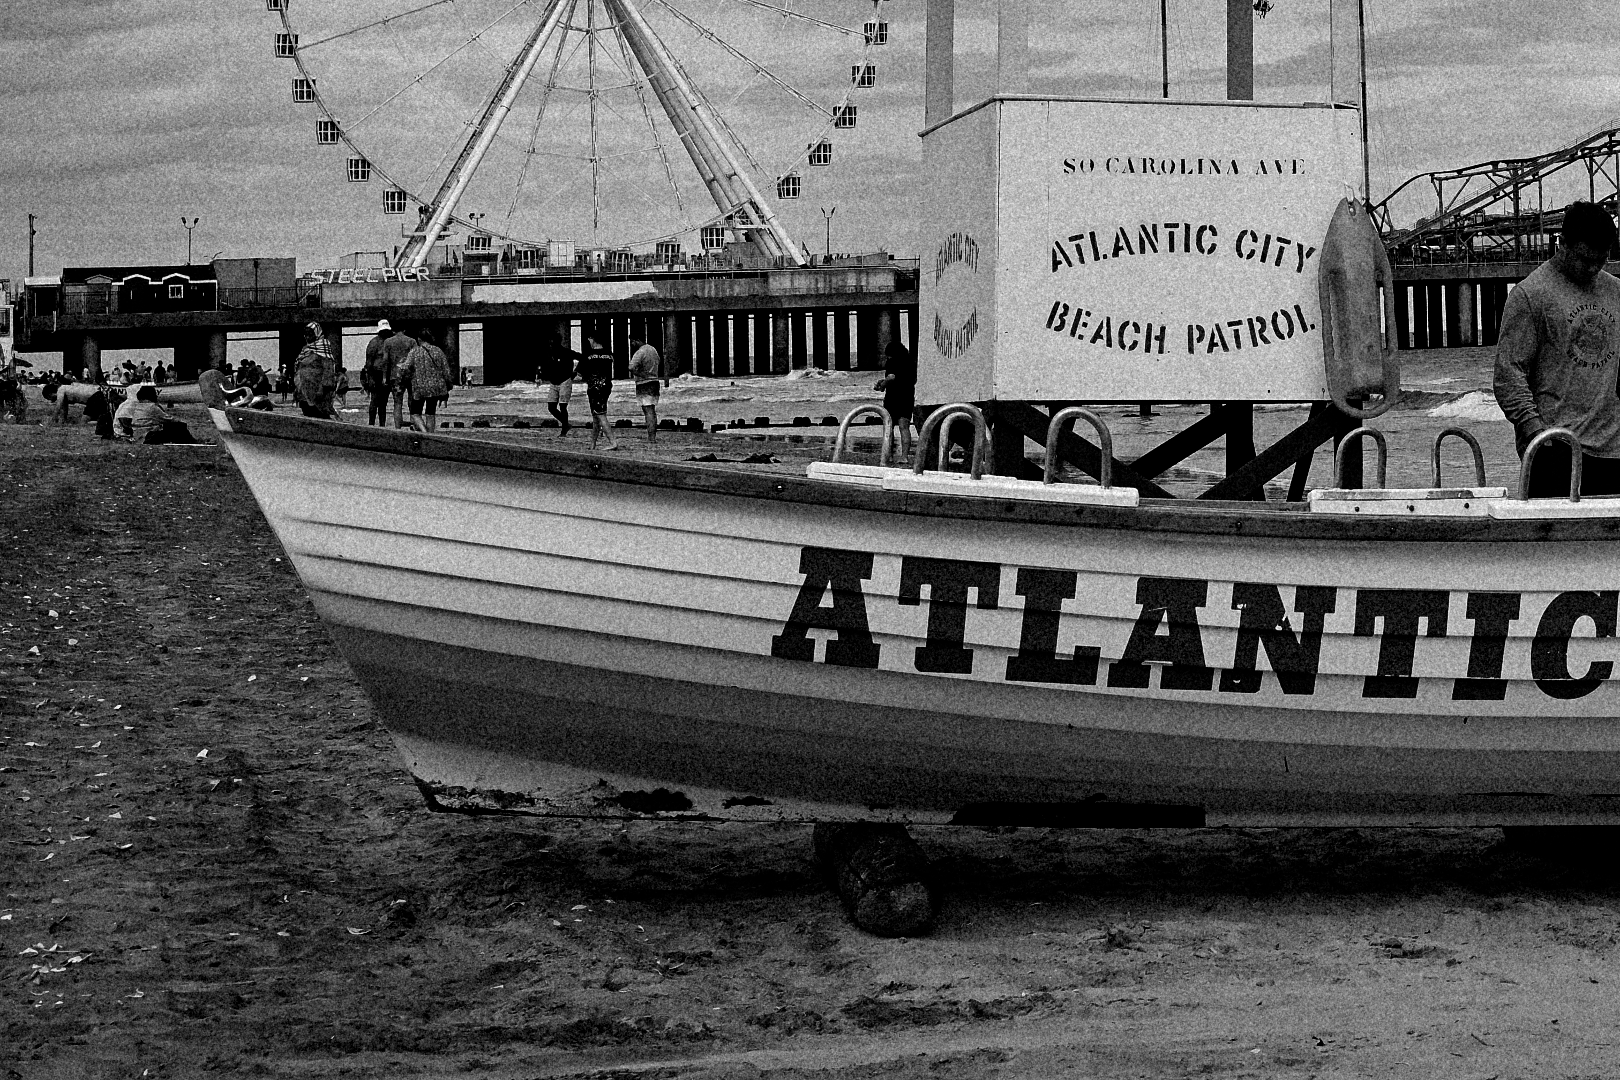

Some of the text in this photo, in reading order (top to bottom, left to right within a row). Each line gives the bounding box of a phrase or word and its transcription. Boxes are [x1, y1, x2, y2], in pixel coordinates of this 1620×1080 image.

[1063, 158, 1095, 174] SO
[1105, 157, 1239, 175] CAROLINA
[935, 231, 979, 286] ATLANTIC CITY
[1051, 222, 1316, 274] ATLANTIC CITY
[311, 266, 431, 284] STEEL PIER
[1046, 301, 1316, 355] BEACH PATROL
[1566, 304, 1616, 324] ATLANTIC CITY
[1591, 350, 1616, 370] PATROL
[770, 546, 1620, 701] ATLANTIC
